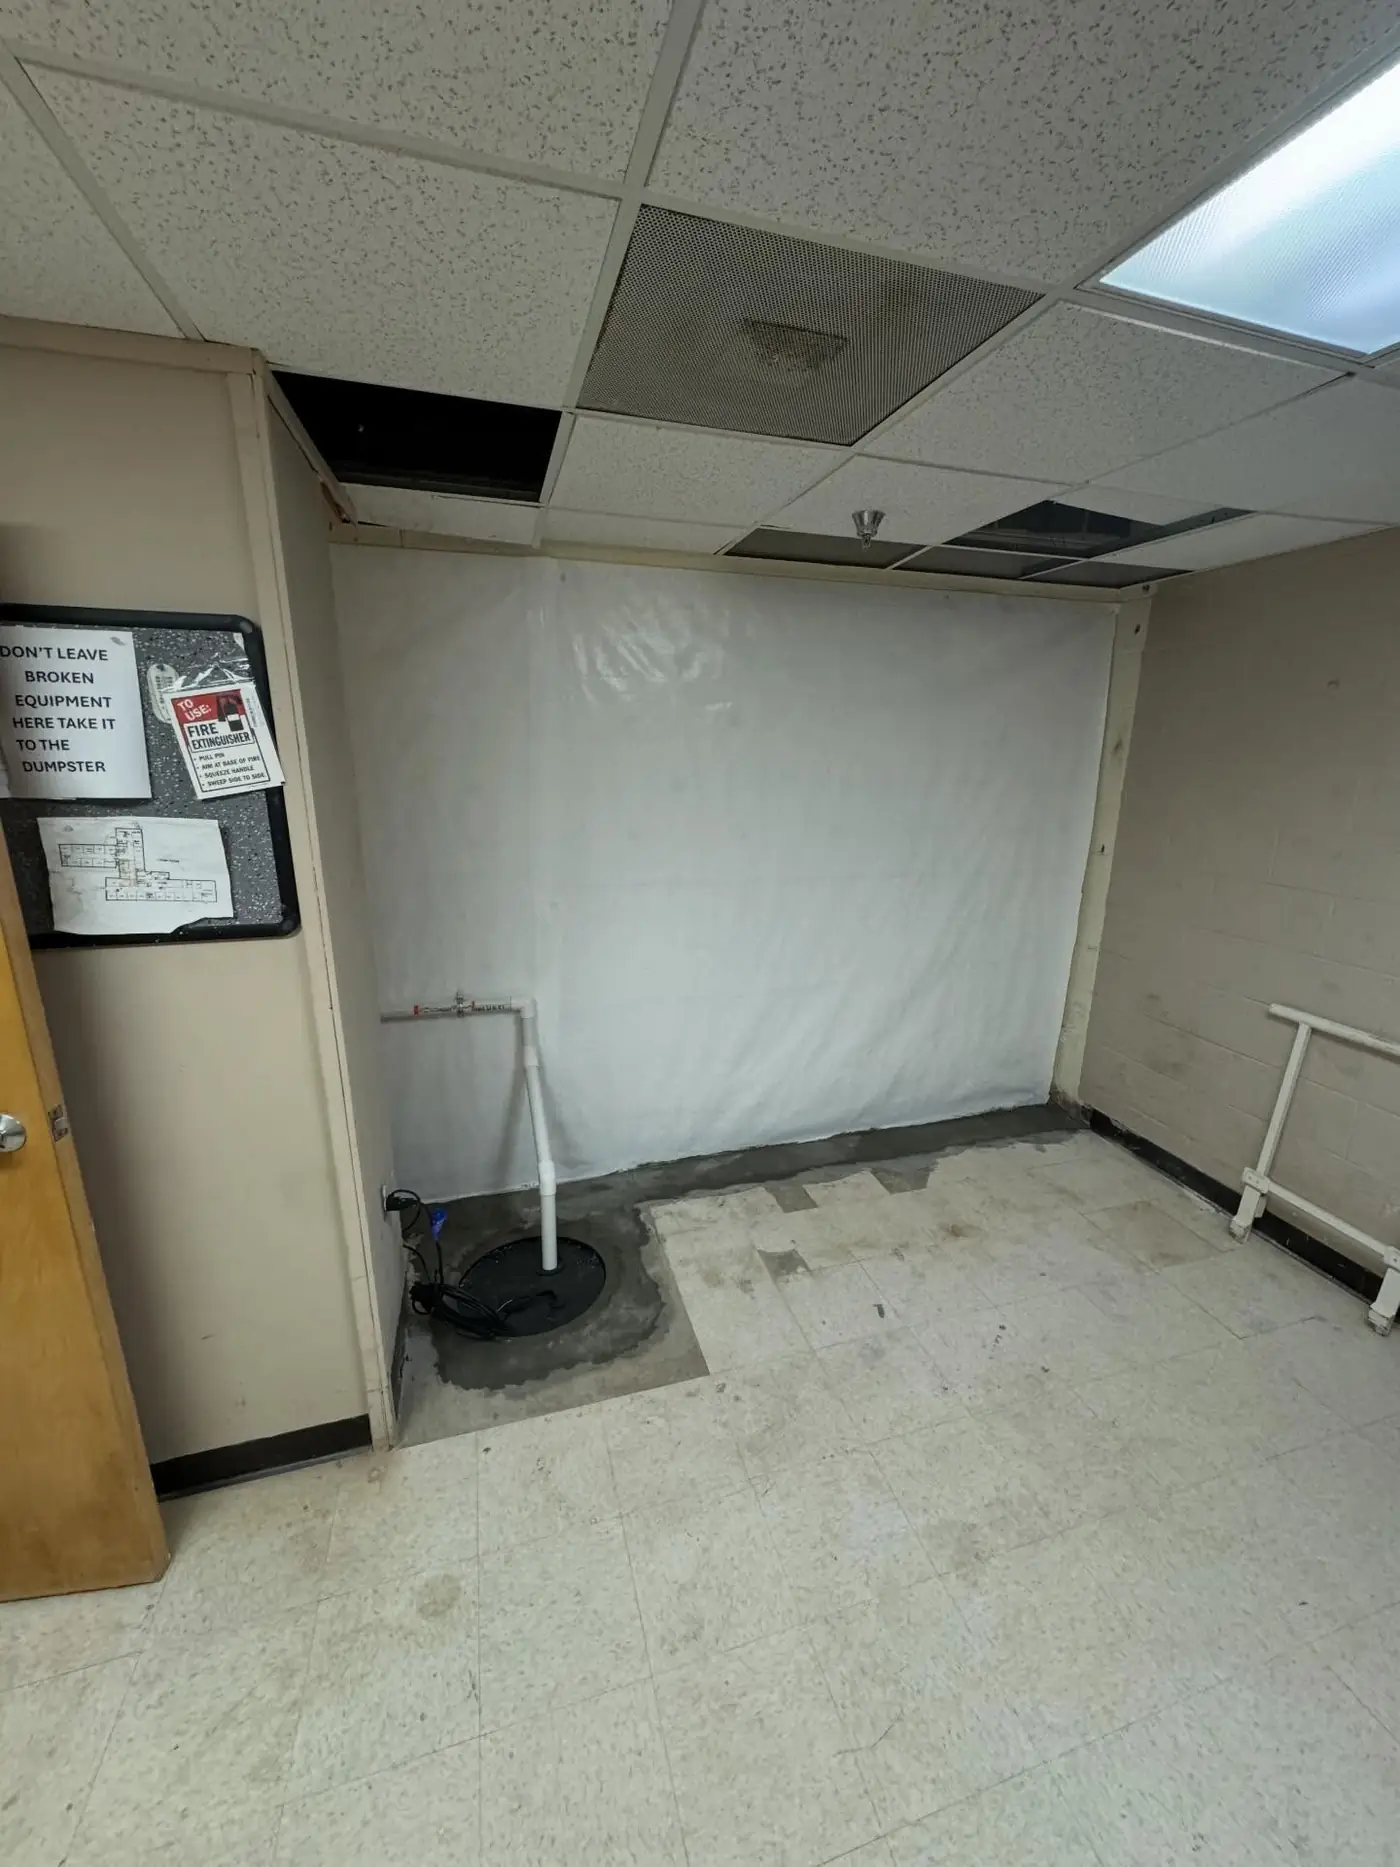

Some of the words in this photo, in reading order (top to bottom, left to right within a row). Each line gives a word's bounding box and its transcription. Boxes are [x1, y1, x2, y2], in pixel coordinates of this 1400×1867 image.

[1, 646, 53, 658] DON'T
[57, 648, 108, 661] LEAVE
[25, 670, 94, 684] BROKEN
[15, 695, 112, 708] EQUIPMENT
[177, 699, 194, 712] TO
[12, 717, 54, 729] HERE
[57, 718, 98, 729] TAKE
[102, 718, 116, 730] IT
[187, 722, 219, 738] FIRE
[16, 739, 36, 751] TO
[39, 739, 70, 751] THE
[191, 732, 251, 750] EXTINGUISHER
[22, 761, 106, 773] DUMPSTER
[204, 769, 230, 778] SQUEEZE
[232, 765, 254, 774] HANDLE
[207, 779, 227, 787] SWEEP
